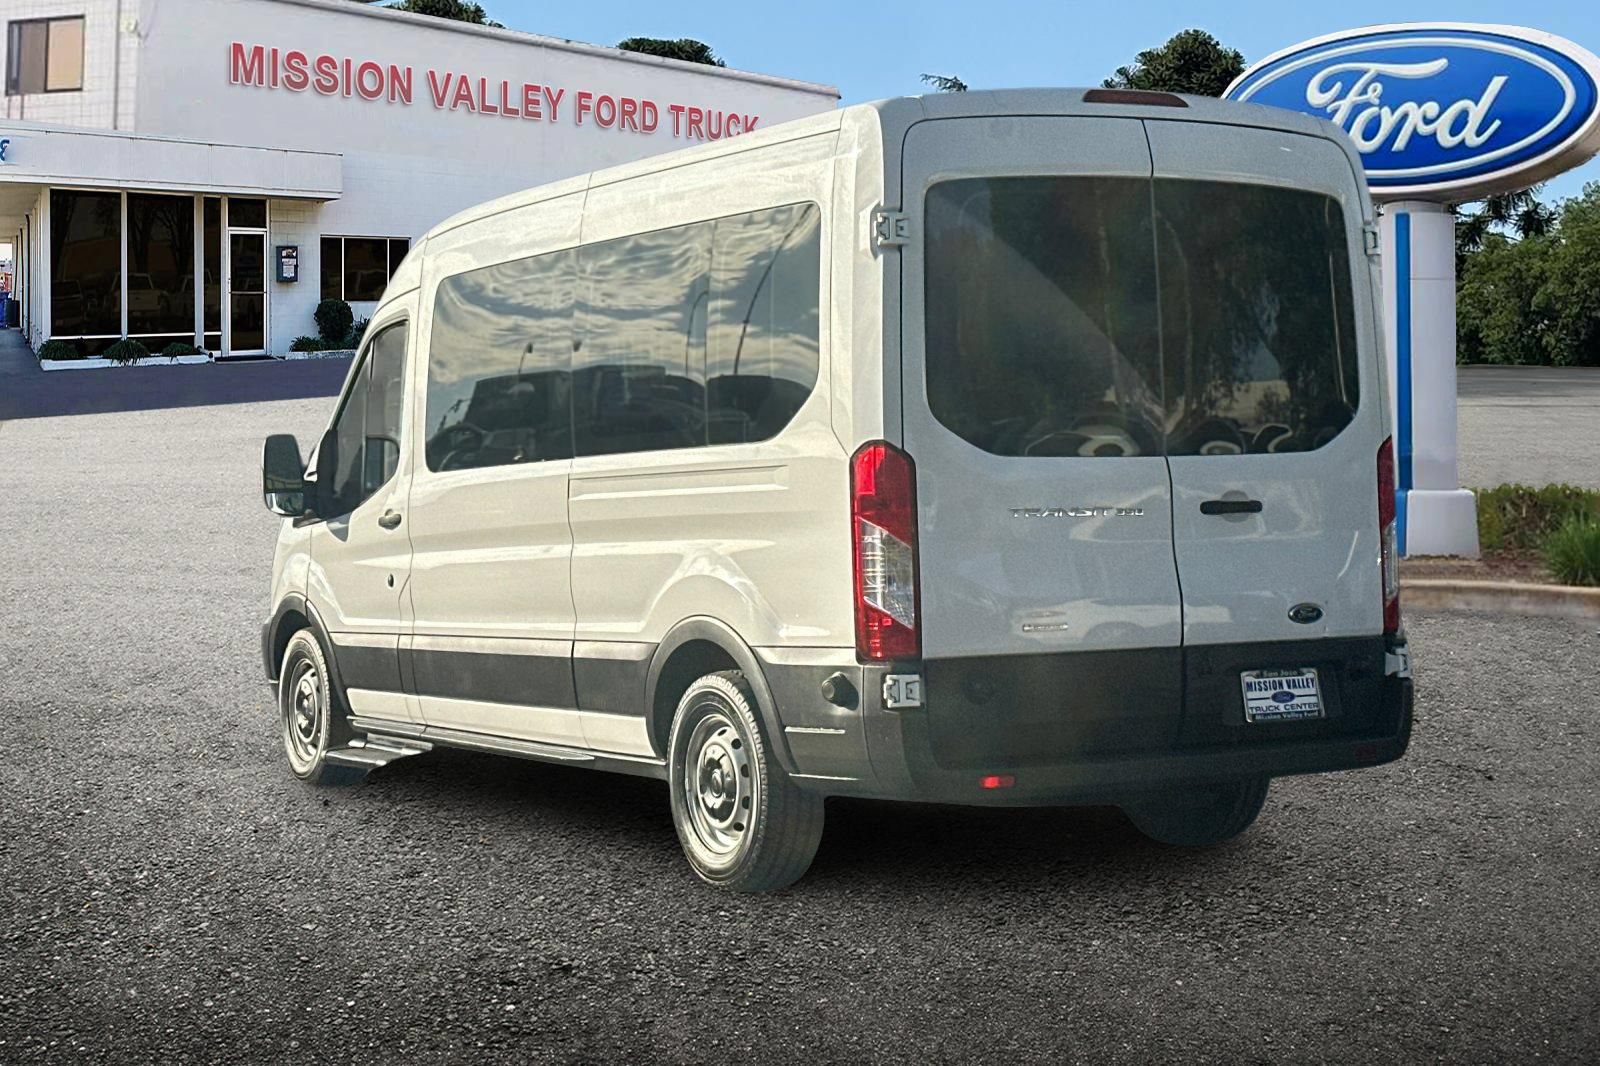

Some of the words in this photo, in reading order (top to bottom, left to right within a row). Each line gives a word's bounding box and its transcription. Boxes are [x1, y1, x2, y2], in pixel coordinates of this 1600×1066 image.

[230, 41, 414, 104] MISSION
[425, 70, 566, 122] VALLEY
[576, 91, 660, 133] FORD
[668, 103, 760, 141] TRUCK
[1306, 58, 1509, 153] Ford
[1008, 506, 1114, 517] TRANSIT
[1246, 680, 1284, 692] MISSION
[1286, 677, 1315, 690] VALLEY
[1249, 704, 1281, 713] TRUCK
[1284, 702, 1318, 711] CENTER
